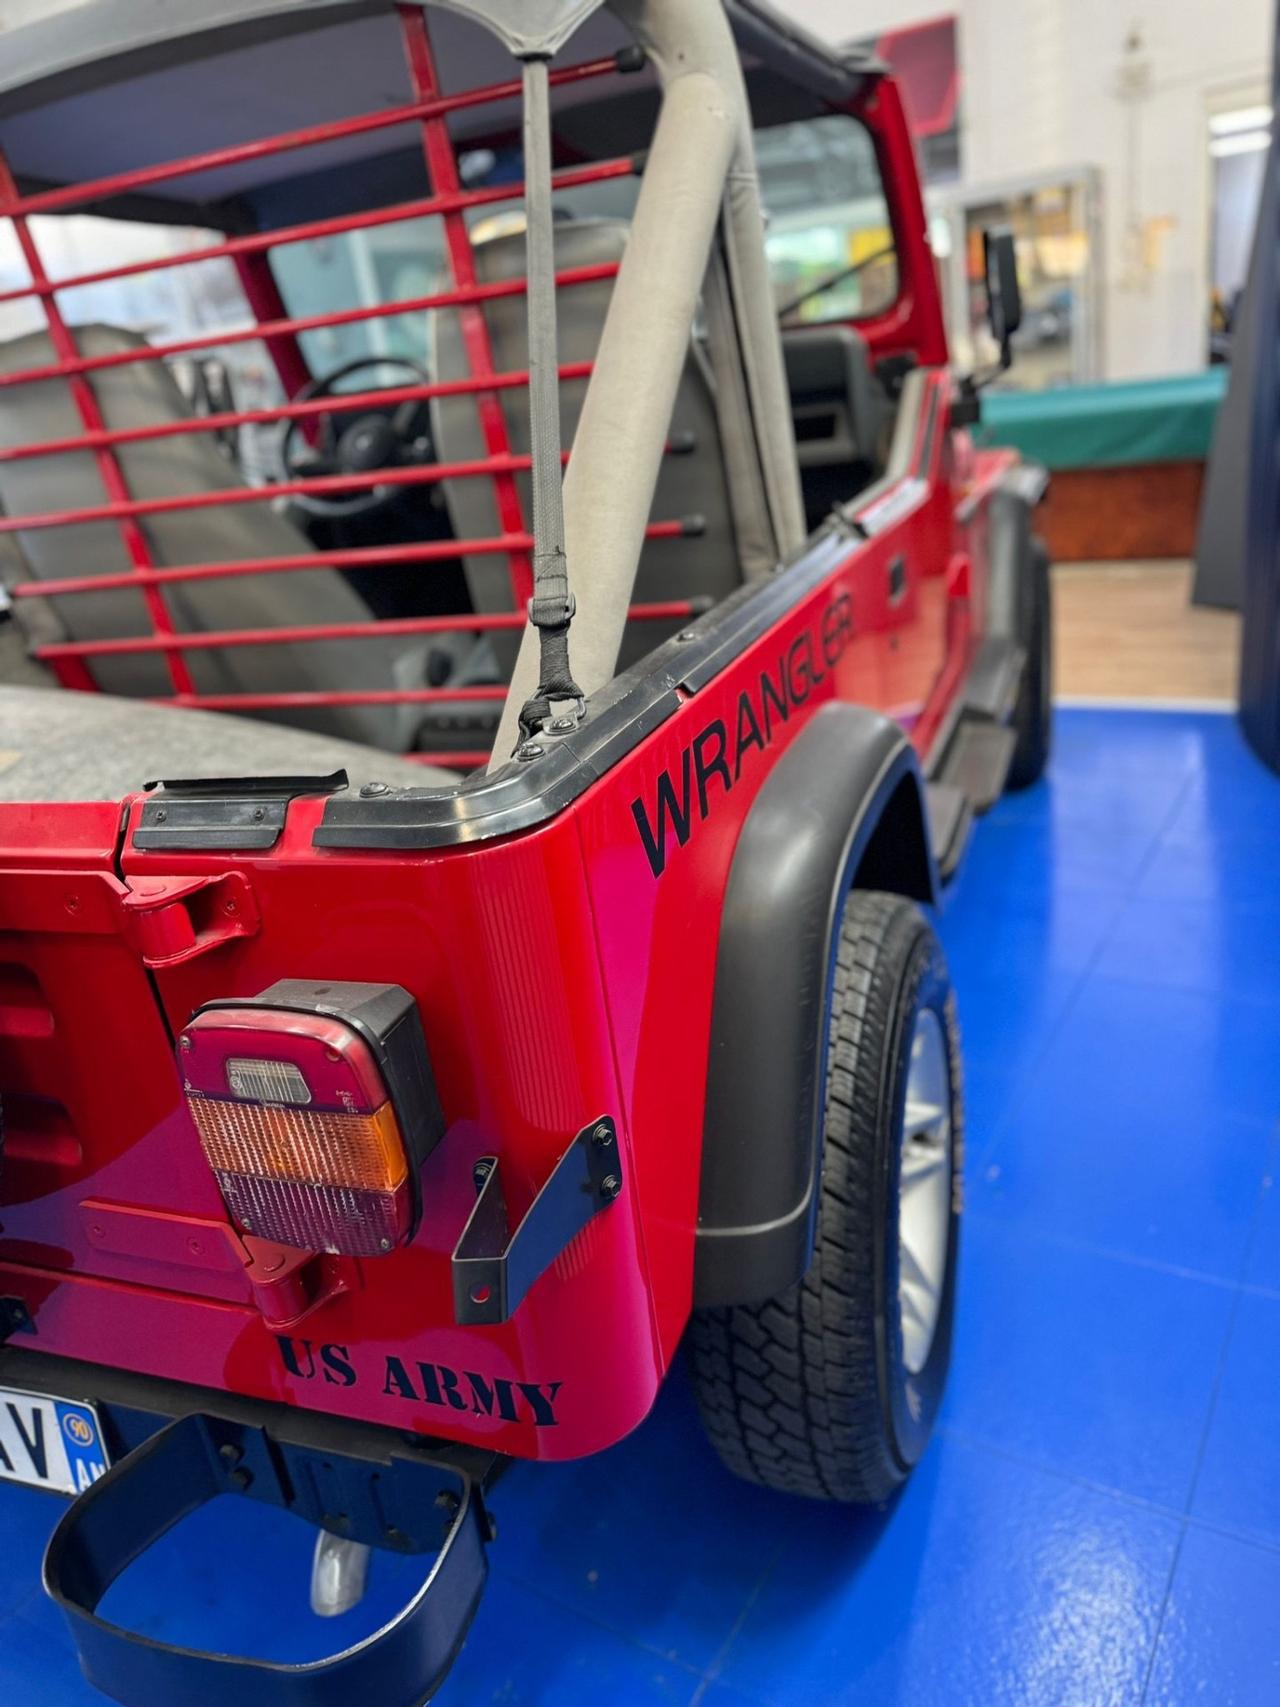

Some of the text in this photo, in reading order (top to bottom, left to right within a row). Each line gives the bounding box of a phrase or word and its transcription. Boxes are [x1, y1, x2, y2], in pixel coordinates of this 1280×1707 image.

[631, 592, 854, 879] WRANGLER
[275, 1335, 562, 1426] US ARMY
